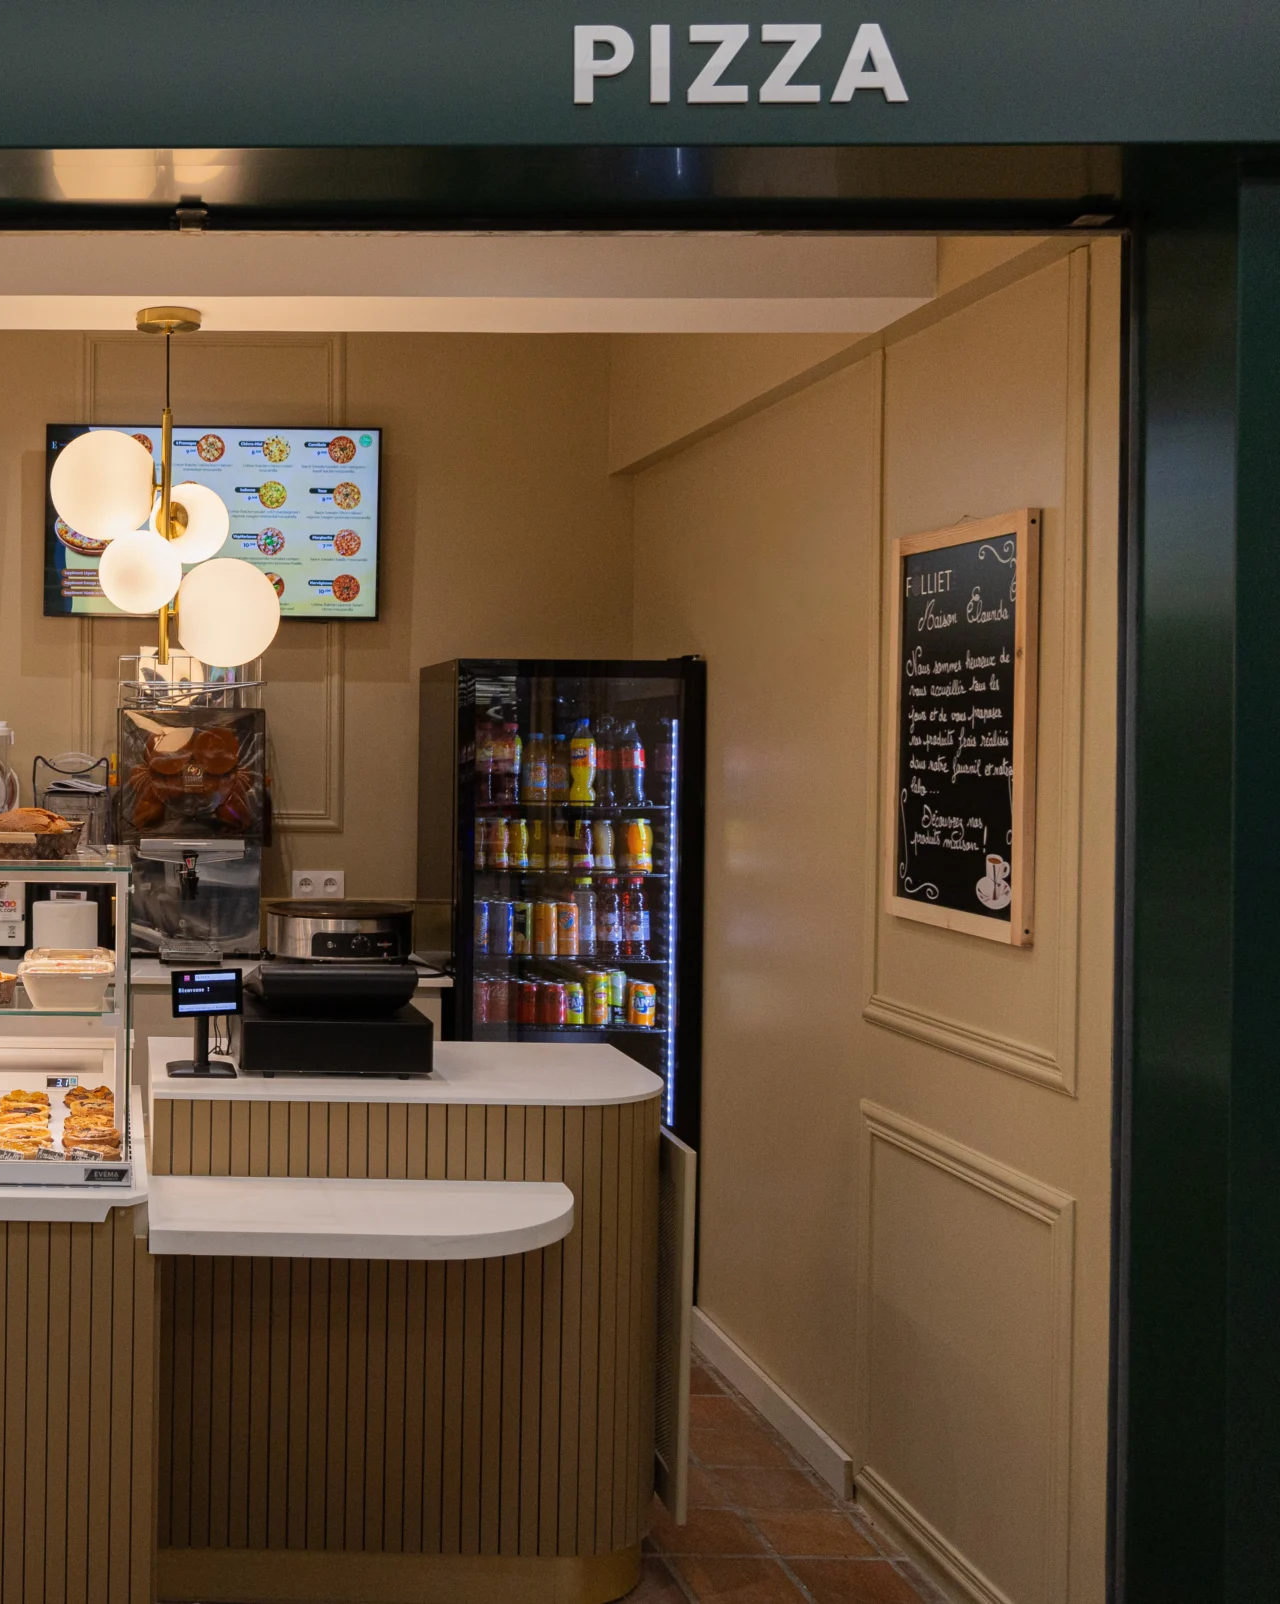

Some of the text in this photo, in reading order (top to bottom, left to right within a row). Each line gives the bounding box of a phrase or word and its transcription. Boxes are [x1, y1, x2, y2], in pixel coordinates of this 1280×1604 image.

[573, 23, 910, 104] PIZZA
[917, 599, 958, 632] Maison
[906, 646, 1010, 676] Nous sommes heureux de
[908, 673, 1000, 697] vous accueillir tous les
[929, 707, 939, 721] et
[938, 707, 948, 722] de
[950, 711, 967, 722] vous
[908, 735, 922, 746] nos
[922, 730, 955, 752] produits
[956, 726, 977, 758] frais
[909, 753, 926, 770] dans
[928, 755, 950, 773] notre
[951, 756, 982, 784] fournil
[984, 763, 994, 776] et
[921, 804, 984, 843] Découvrez nos
[910, 829, 941, 856] produits
[942, 833, 980, 852] maison
